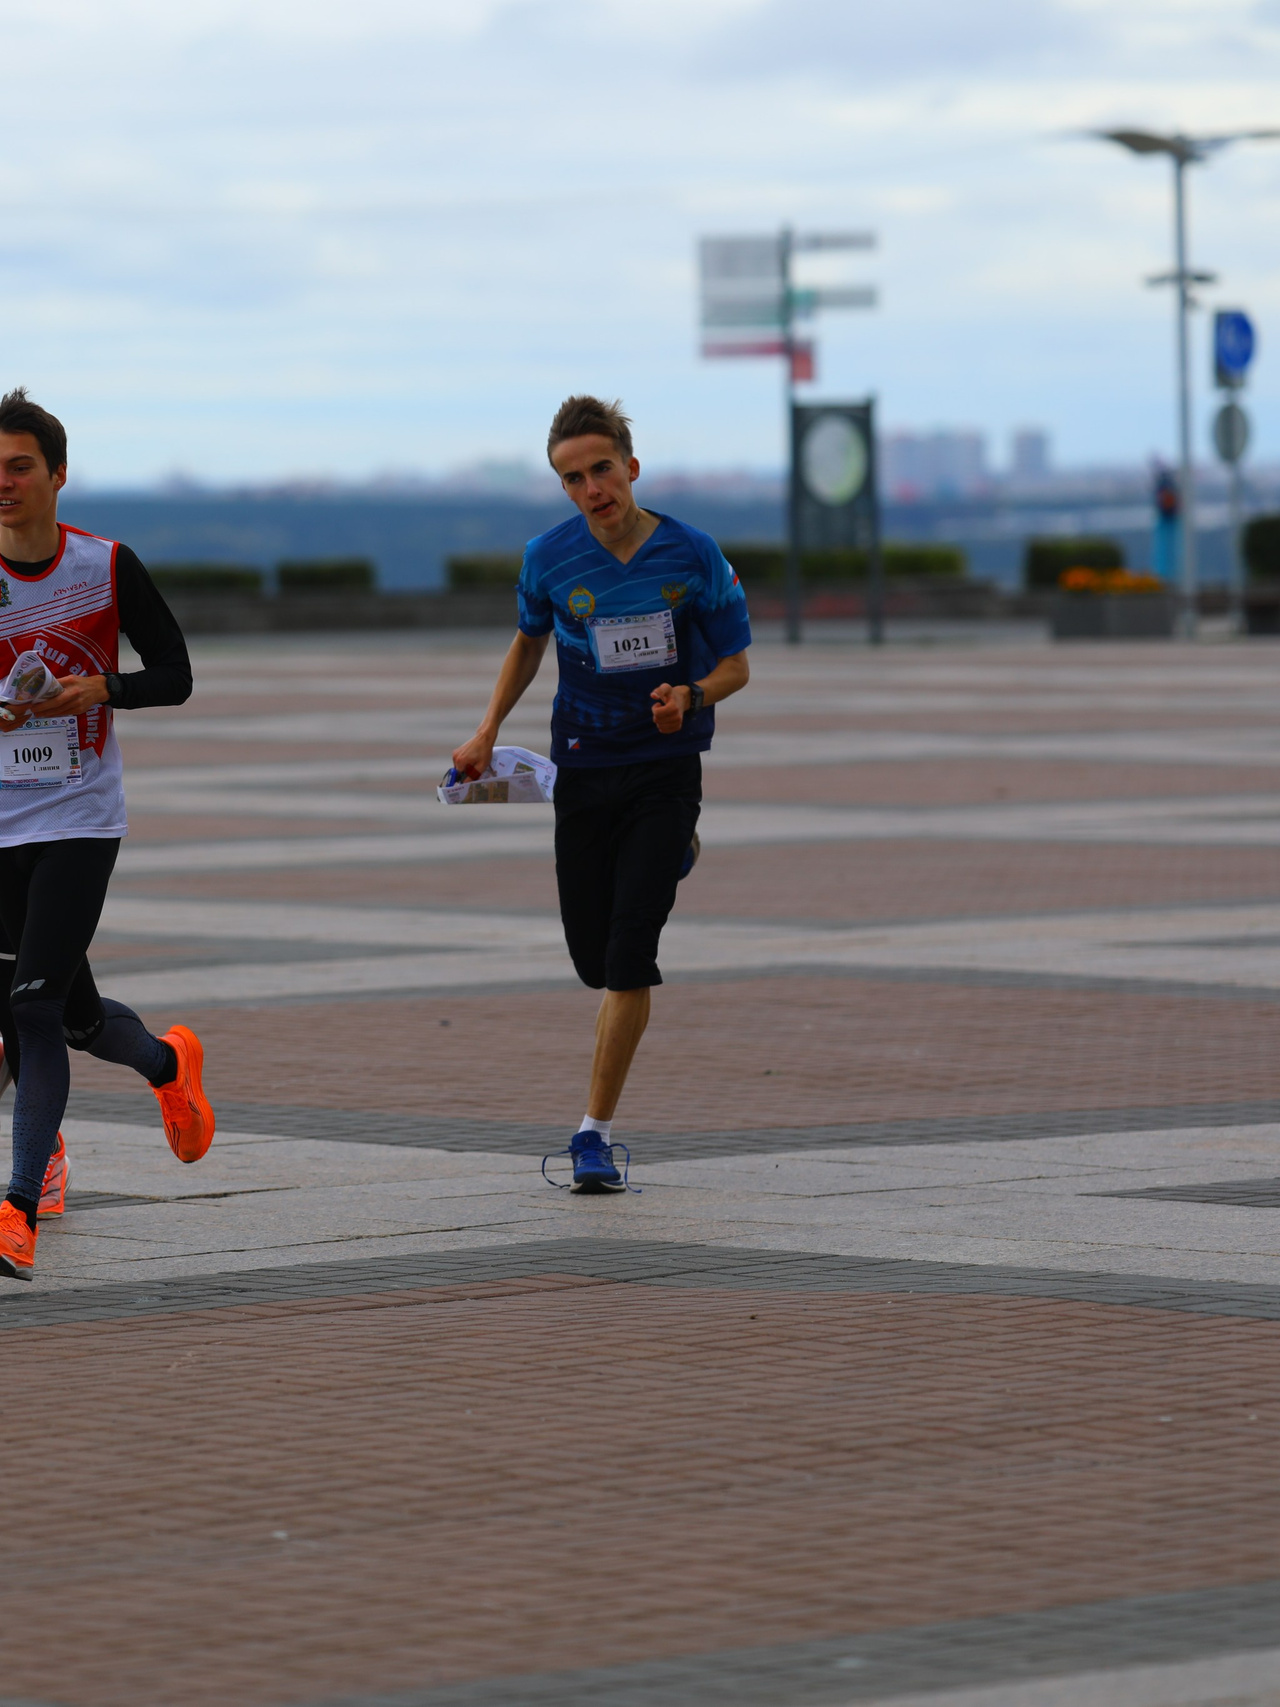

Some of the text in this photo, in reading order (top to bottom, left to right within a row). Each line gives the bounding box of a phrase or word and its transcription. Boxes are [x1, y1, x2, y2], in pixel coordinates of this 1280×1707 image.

[613, 636, 650, 653] 1021
[33, 638, 69, 667] Run
[85, 703, 103, 744] hink
[13, 746, 53, 764] 1009
